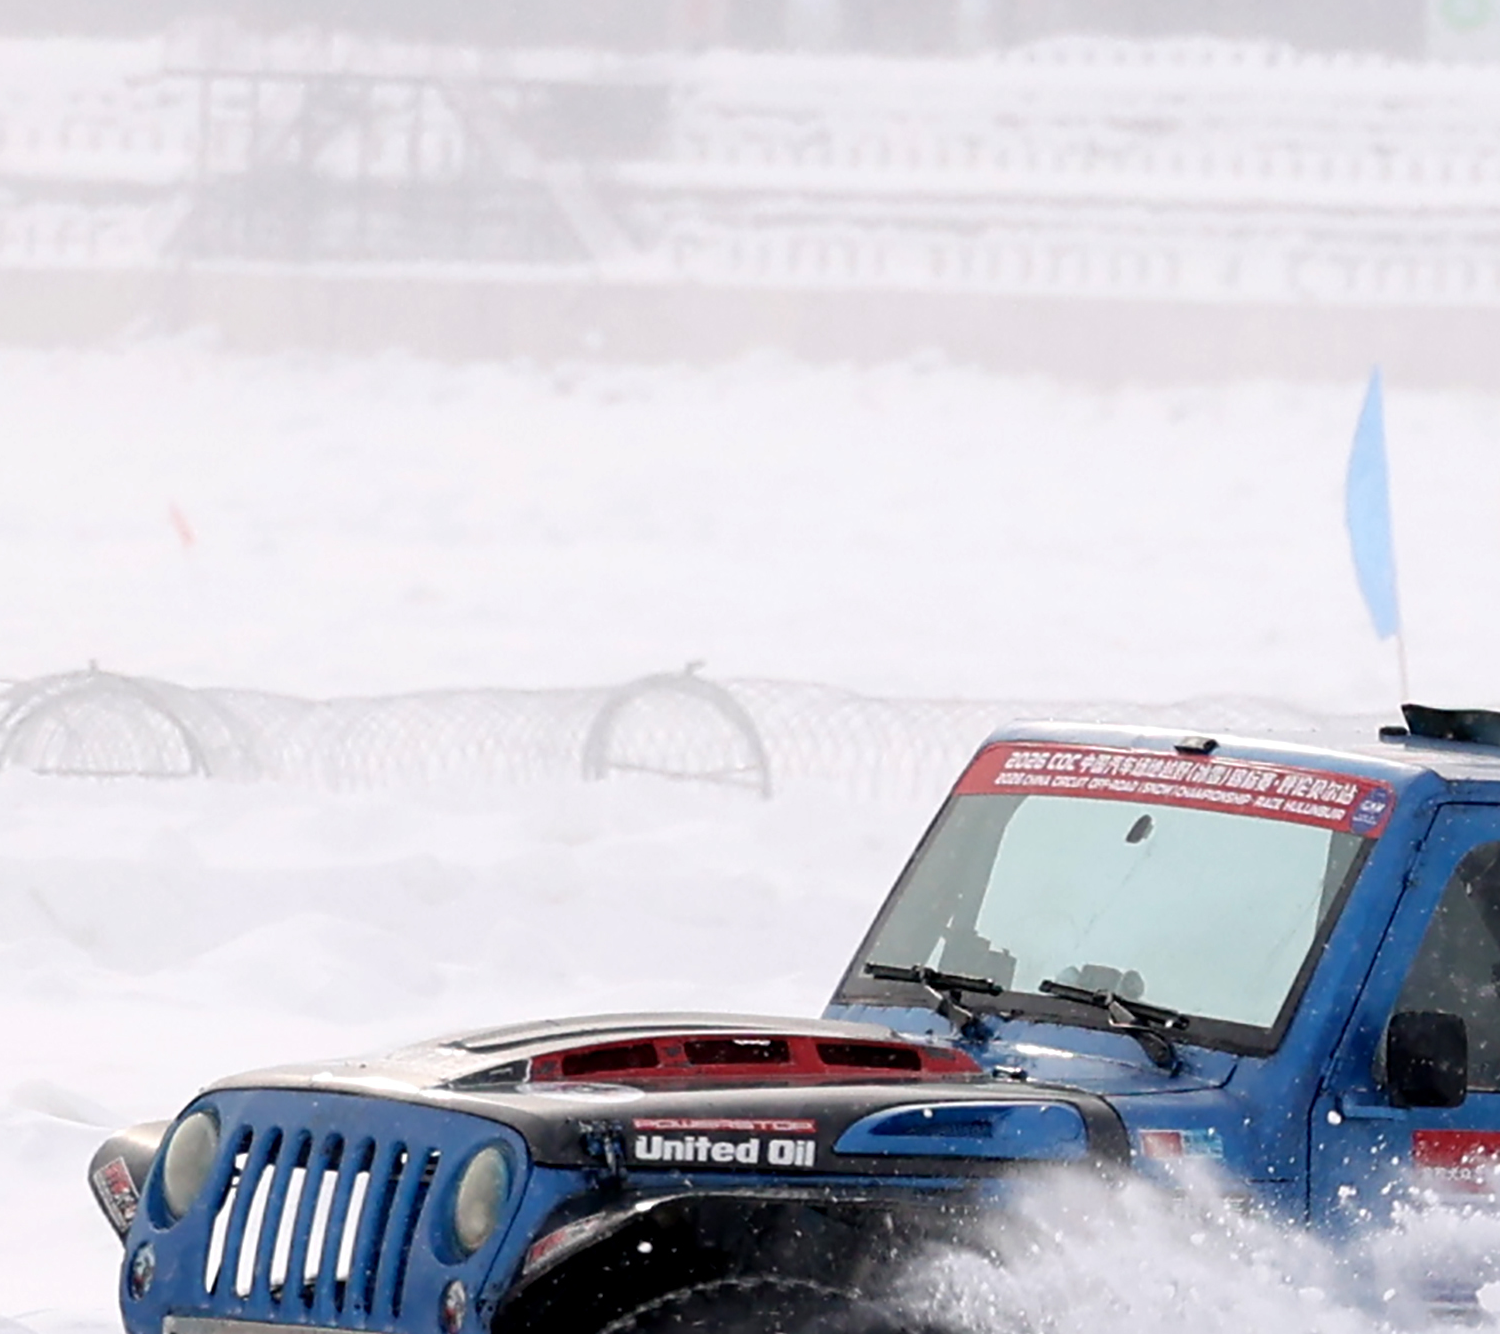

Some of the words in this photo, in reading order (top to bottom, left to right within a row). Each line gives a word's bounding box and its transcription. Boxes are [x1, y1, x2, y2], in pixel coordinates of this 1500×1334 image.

[1047, 752, 1083, 770] COC
[1023, 774, 1052, 786] CHINA
[1051, 775, 1089, 789] CIRCUIT
[1088, 777, 1138, 792] OFF-ROAD
[1254, 796, 1284, 810] RACE
[634, 1135, 760, 1164] United
[767, 1139, 816, 1167] Oil
